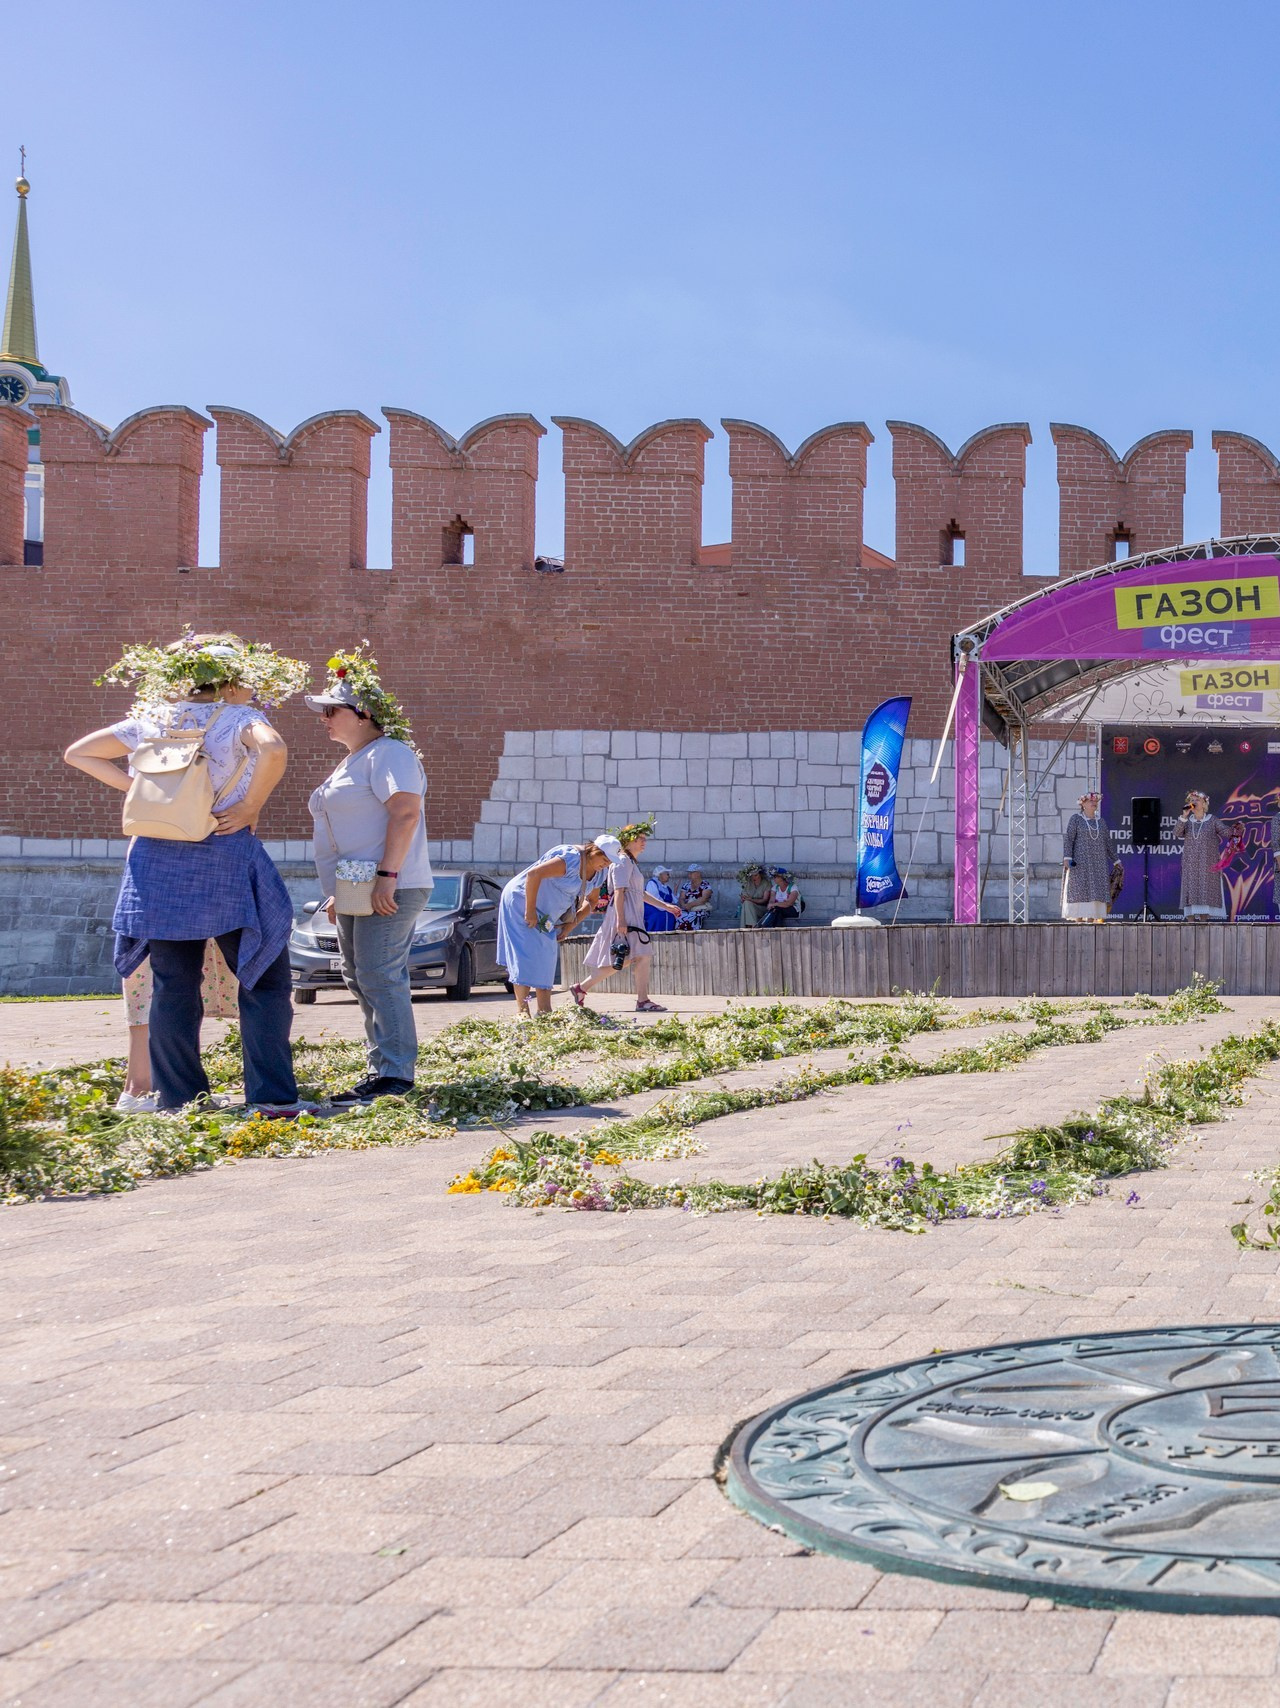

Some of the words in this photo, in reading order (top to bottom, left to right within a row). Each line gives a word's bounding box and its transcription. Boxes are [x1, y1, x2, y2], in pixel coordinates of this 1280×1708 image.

[1135, 585, 1261, 620] ГАЗОН
[1160, 624, 1233, 649] фест
[1192, 669, 1270, 691] ГАЗОН
[1207, 693, 1252, 709] фест
[1117, 844, 1134, 854] НА
[1160, 913, 1187, 921] воркау
[1234, 913, 1270, 921] граффити
